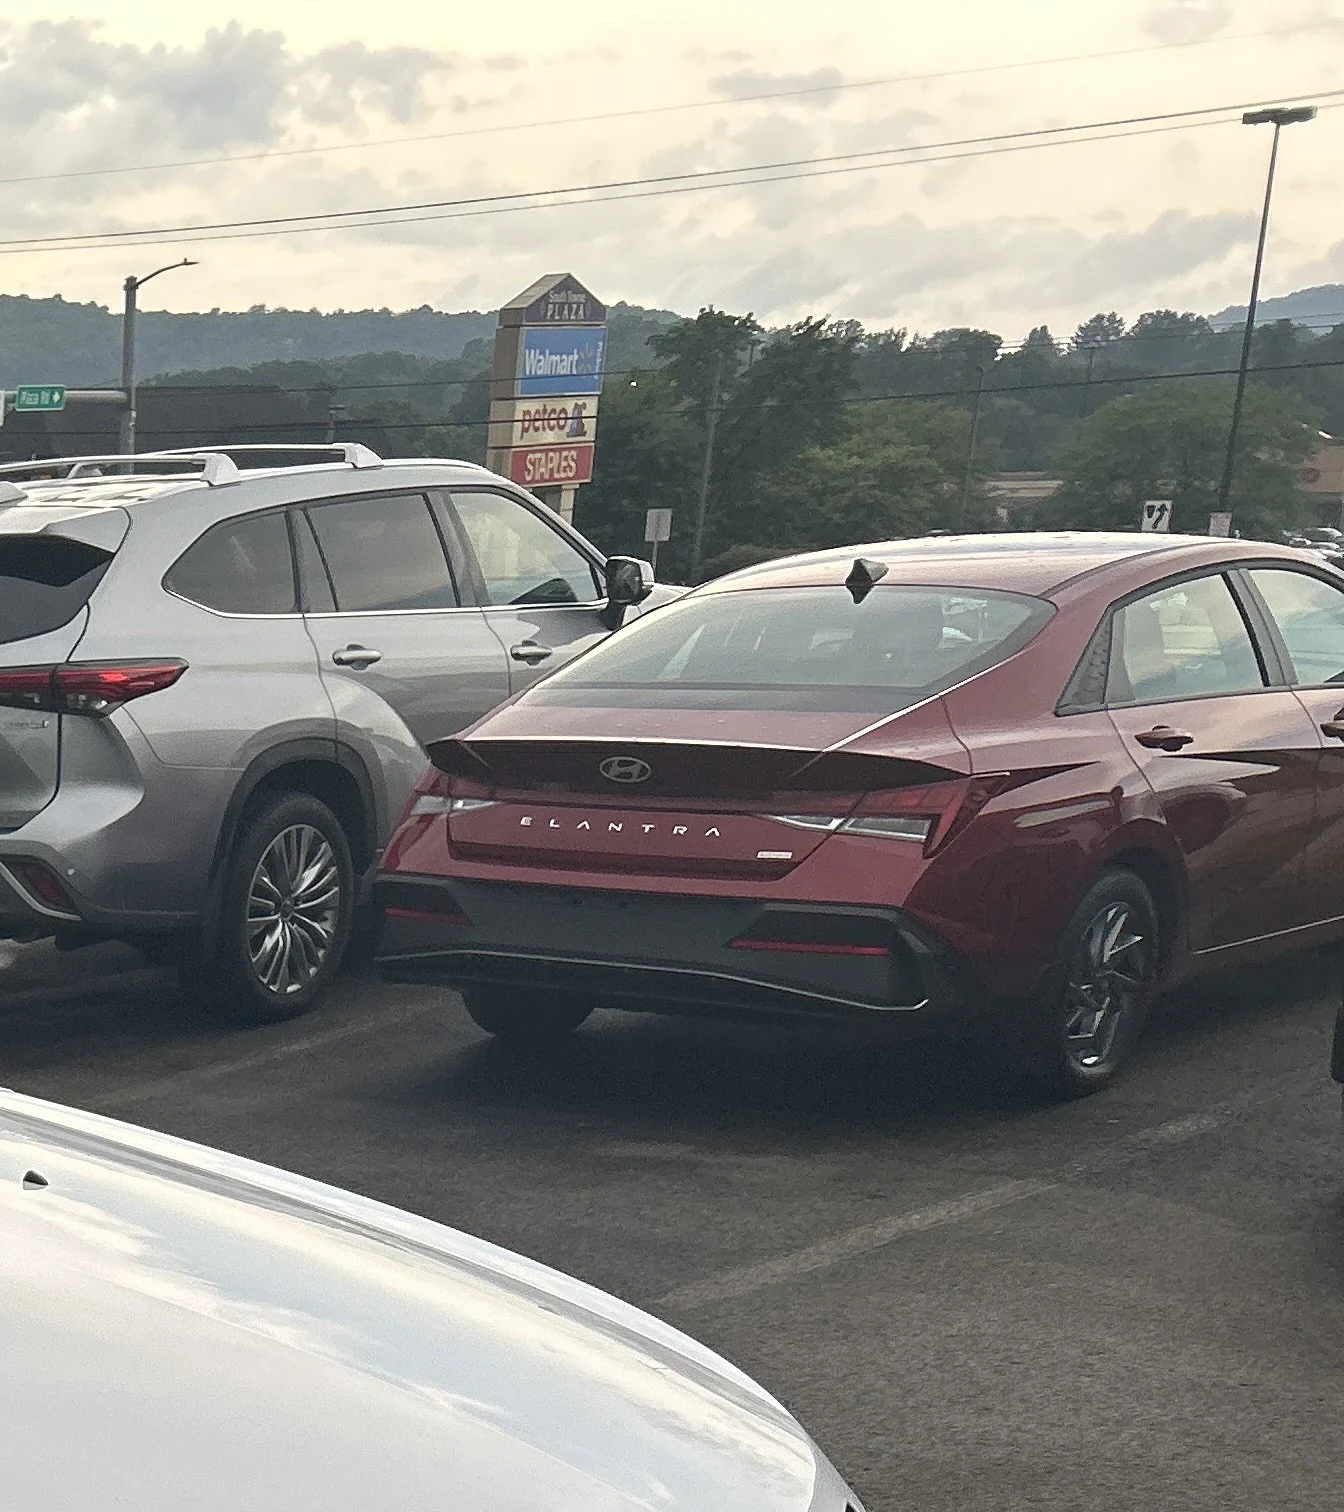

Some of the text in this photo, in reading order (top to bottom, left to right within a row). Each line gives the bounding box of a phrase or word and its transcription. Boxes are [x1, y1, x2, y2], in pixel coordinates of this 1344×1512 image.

[546, 303, 585, 320] PLAZA
[525, 348, 579, 376] Walmart
[520, 403, 569, 440] petco
[524, 450, 577, 481] STAPLES
[520, 816, 720, 837] ELANTRA
